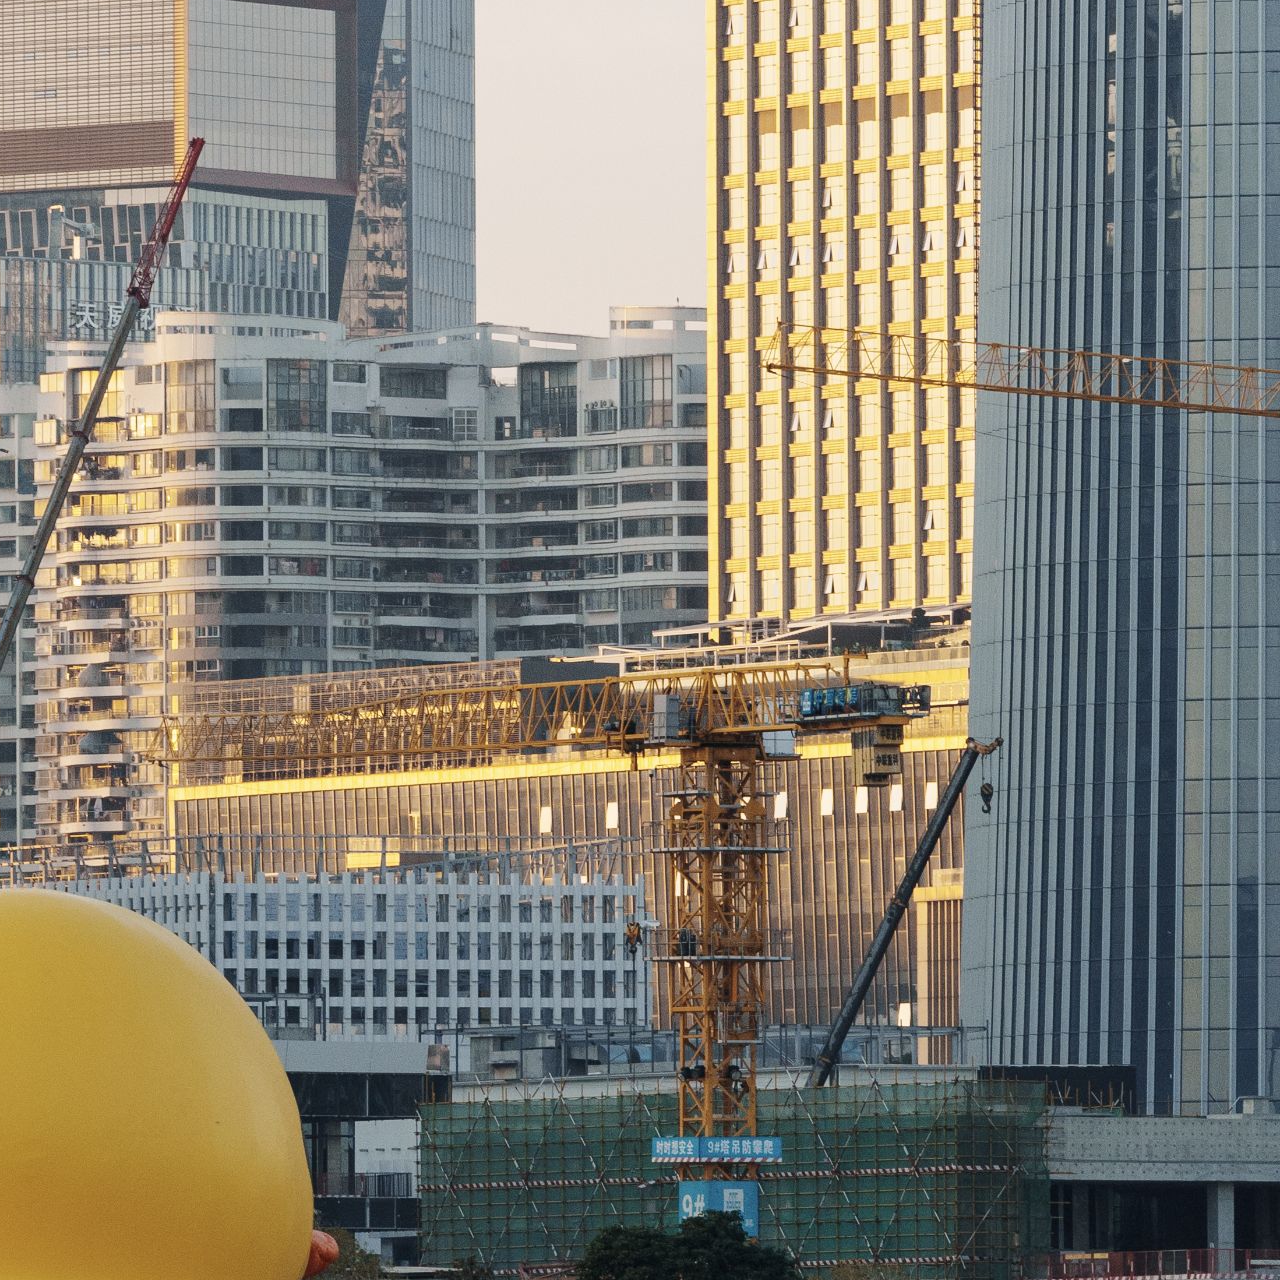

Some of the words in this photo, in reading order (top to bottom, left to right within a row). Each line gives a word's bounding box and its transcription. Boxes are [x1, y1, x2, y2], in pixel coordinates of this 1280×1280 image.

[75, 302, 195, 331] 天威视
[656, 1140, 694, 1155] 时时想安全
[682, 1194, 705, 1218] 9#
